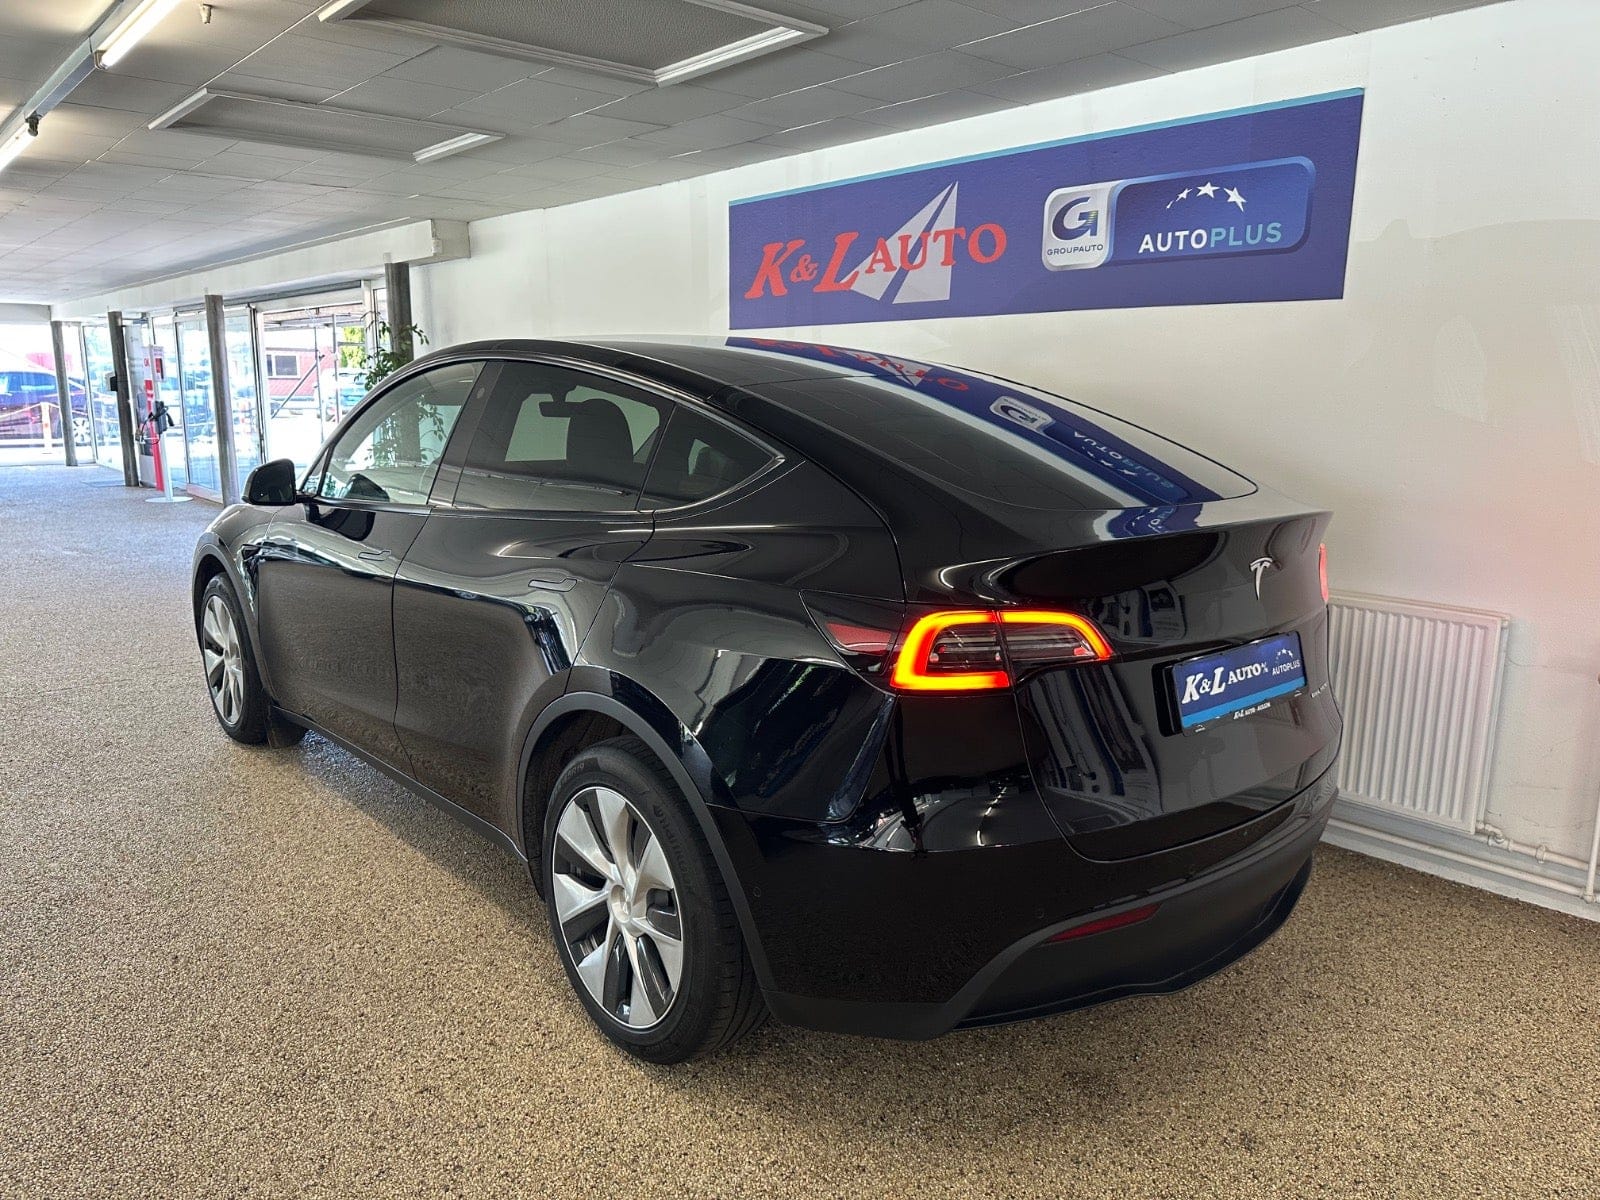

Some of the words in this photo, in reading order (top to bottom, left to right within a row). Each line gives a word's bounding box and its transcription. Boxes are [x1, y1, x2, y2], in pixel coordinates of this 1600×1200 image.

[1046, 243, 1104, 256] GROUPAUTO
[1138, 222, 1283, 254] AUTOPLUS
[744, 231, 859, 299] K&L
[865, 223, 1007, 274] AUTO
[1181, 666, 1227, 704] K&L
[1227, 663, 1262, 685] AUTO
[1271, 658, 1301, 677] AUTOPLUS
